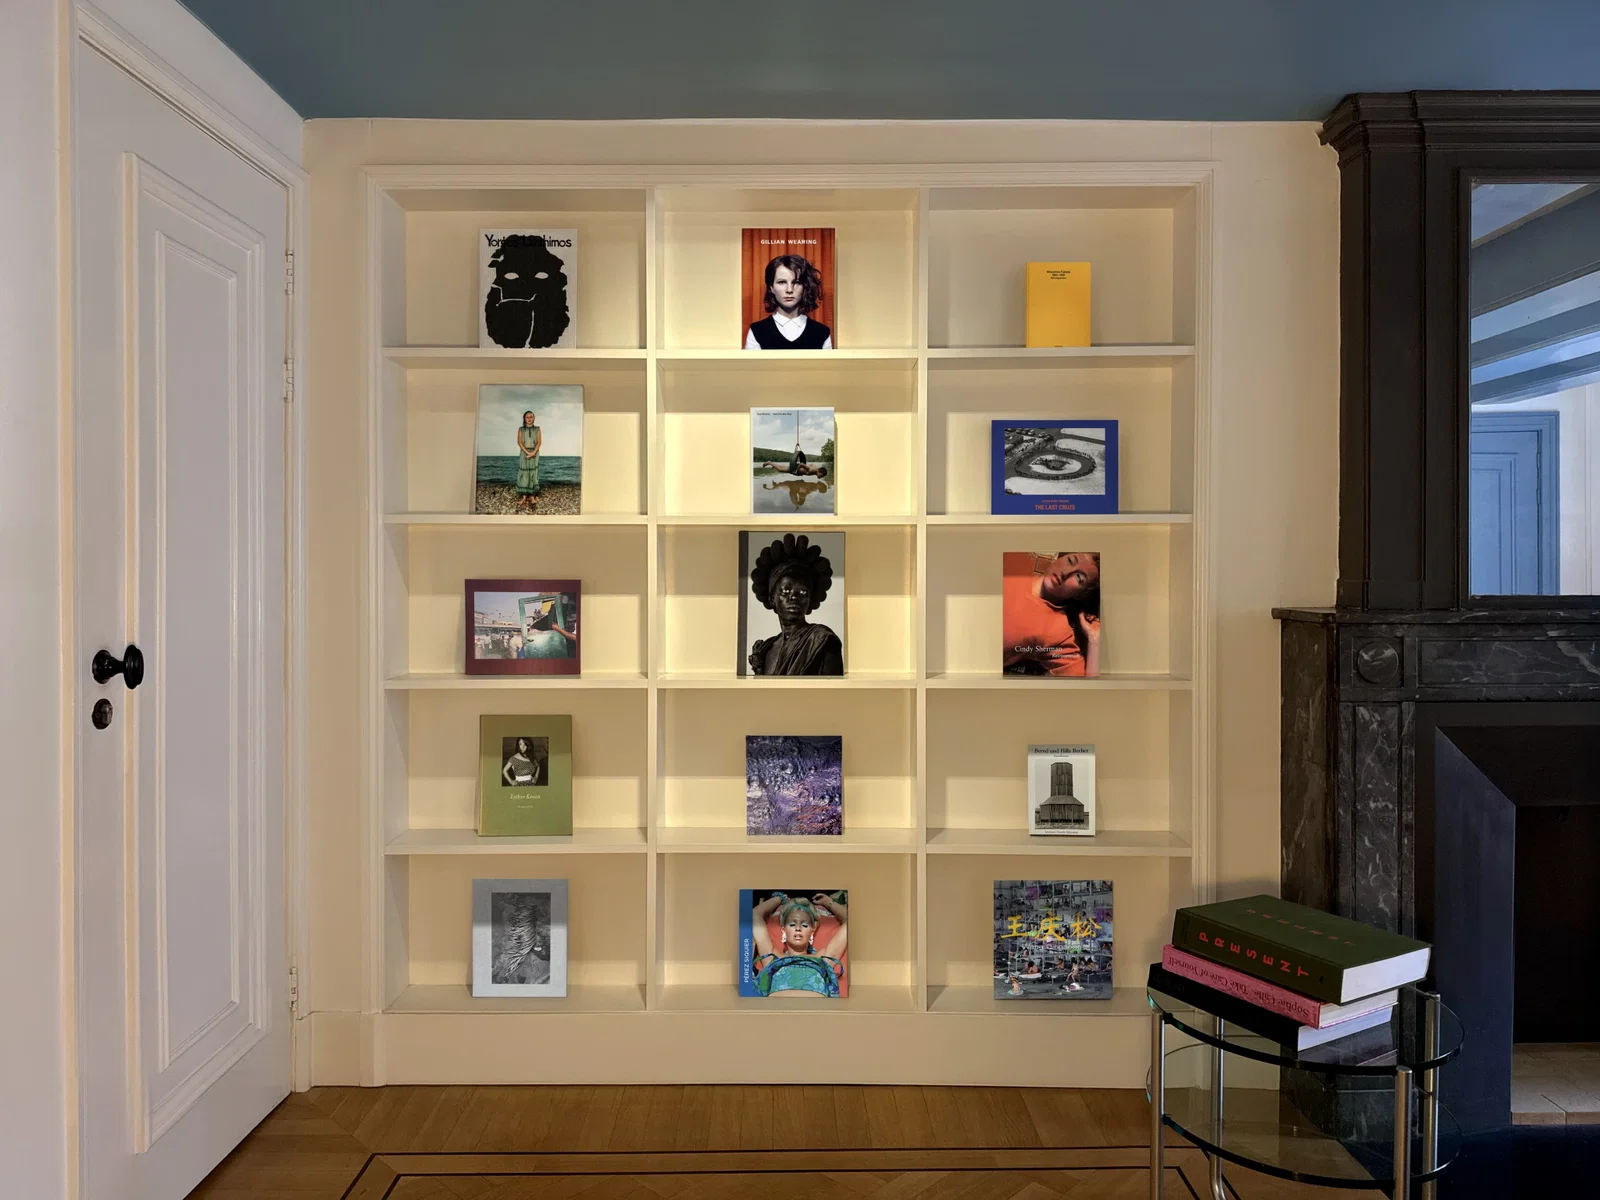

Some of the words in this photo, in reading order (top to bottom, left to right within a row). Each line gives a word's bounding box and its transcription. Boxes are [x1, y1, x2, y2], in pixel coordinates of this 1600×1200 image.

[1014, 645, 1034, 653] Cindy
[1035, 645, 1063, 653] Sherman
[1198, 931, 1310, 977] PRESENT
[1168, 956, 1198, 976] Yourself
[1199, 969, 1209, 977] of
[1209, 973, 1228, 987] Care
[1230, 980, 1248, 995] Take
[1278, 1000, 1310, 1018] Sophie
